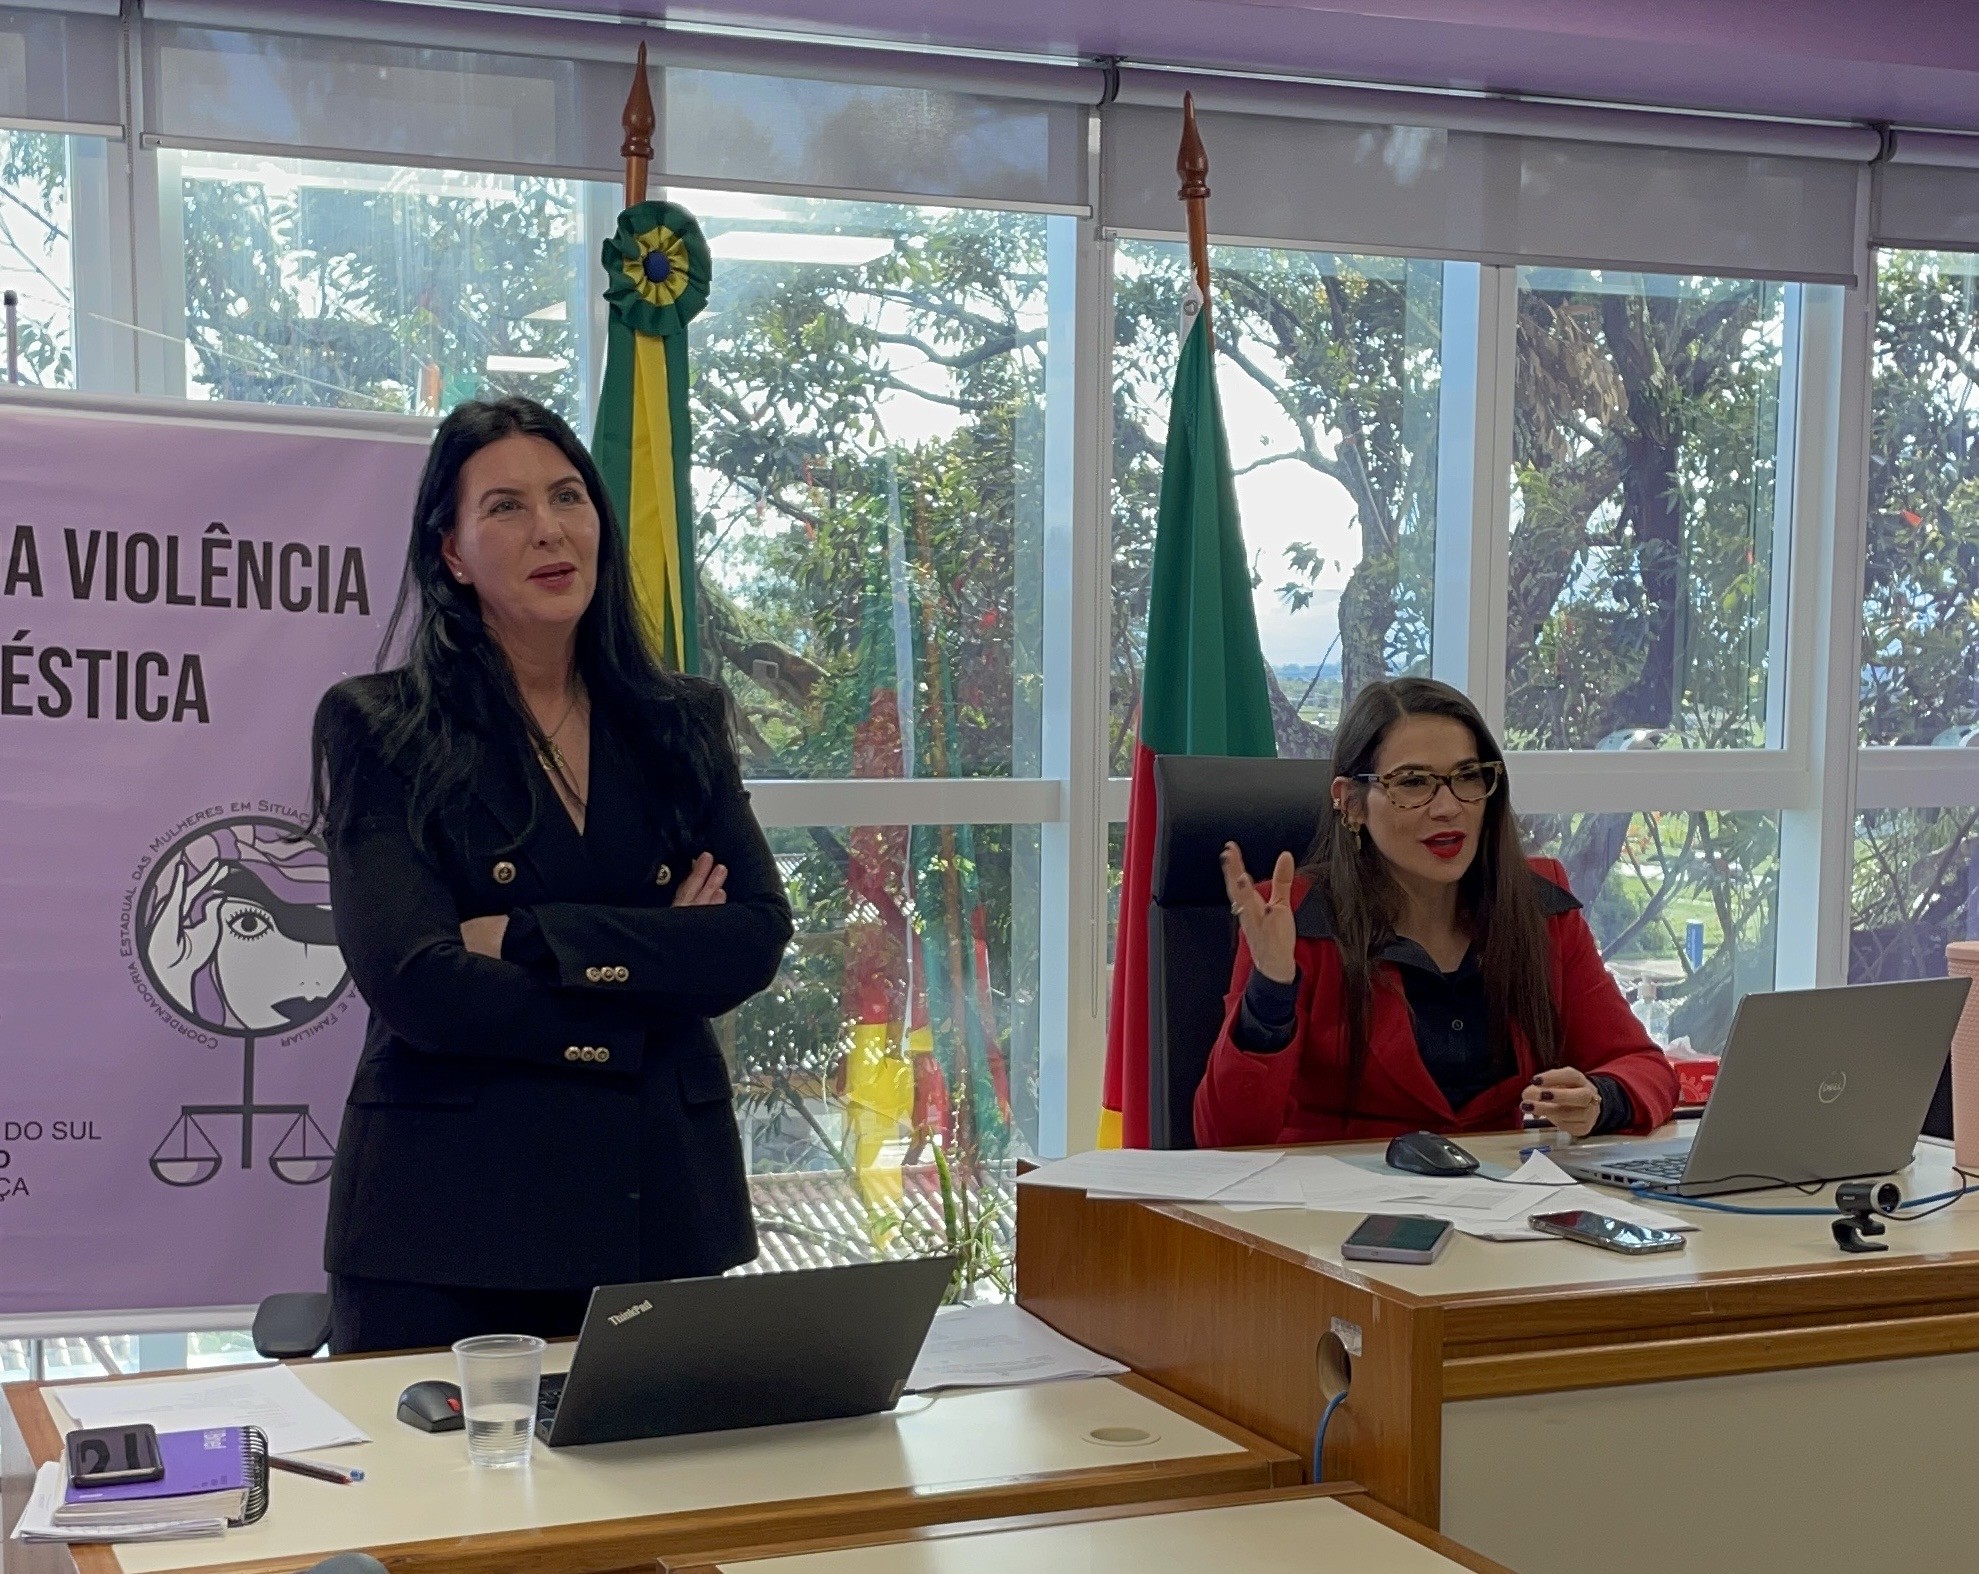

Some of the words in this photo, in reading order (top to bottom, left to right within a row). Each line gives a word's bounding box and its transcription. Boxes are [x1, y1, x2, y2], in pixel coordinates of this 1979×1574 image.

[4, 525, 43, 597] A
[64, 521, 370, 616] VIOLÊNCIA
[1, 629, 210, 723] ÉSTICA
[231, 802, 251, 812] EM
[258, 800, 310, 825] SITUAÇ
[150, 805, 224, 852] MULHERES
[132, 855, 151, 880] DAS
[121, 886, 138, 957] ESTADUAL
[128, 961, 218, 1049] COORDENADORIA
[281, 1013, 338, 1047] FAMILIAR
[5, 1121, 43, 1140] DO
[52, 1121, 101, 1140] SUL
[607, 1299, 653, 1326] ThinkPad
